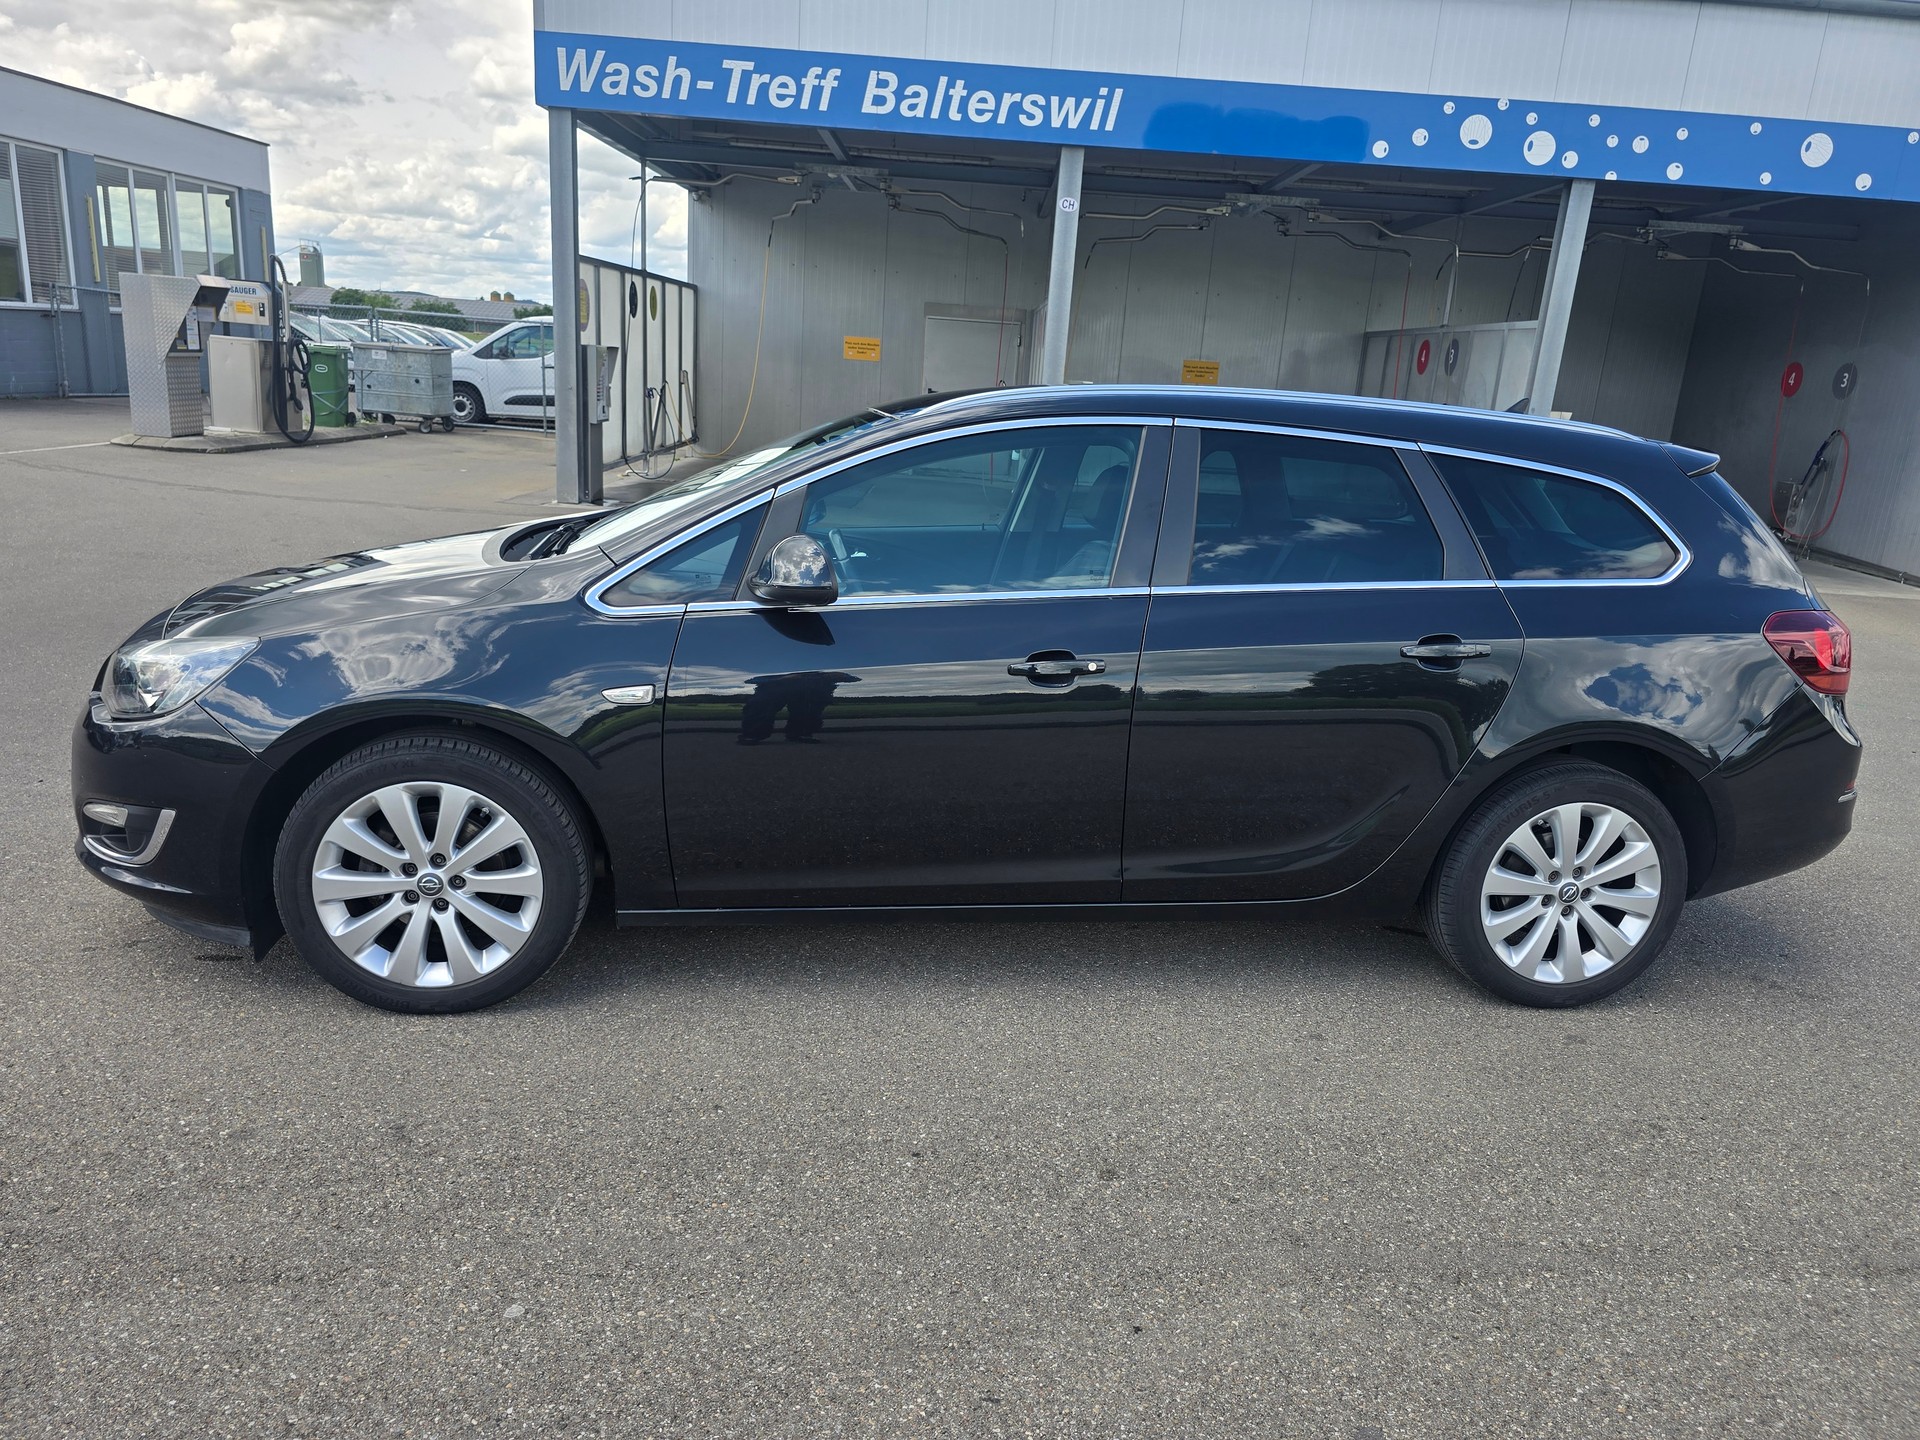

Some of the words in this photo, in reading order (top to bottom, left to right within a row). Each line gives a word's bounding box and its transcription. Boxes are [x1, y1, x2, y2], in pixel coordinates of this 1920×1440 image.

[556, 47, 842, 112] Wash-Treff
[861, 70, 1124, 132] Balterswil
[1061, 198, 1075, 210] CH
[230, 285, 257, 296] SAUGER
[1788, 372, 1796, 386] 4
[1840, 372, 1849, 388] 3
[1483, 795, 1540, 847] BRAVURIS
